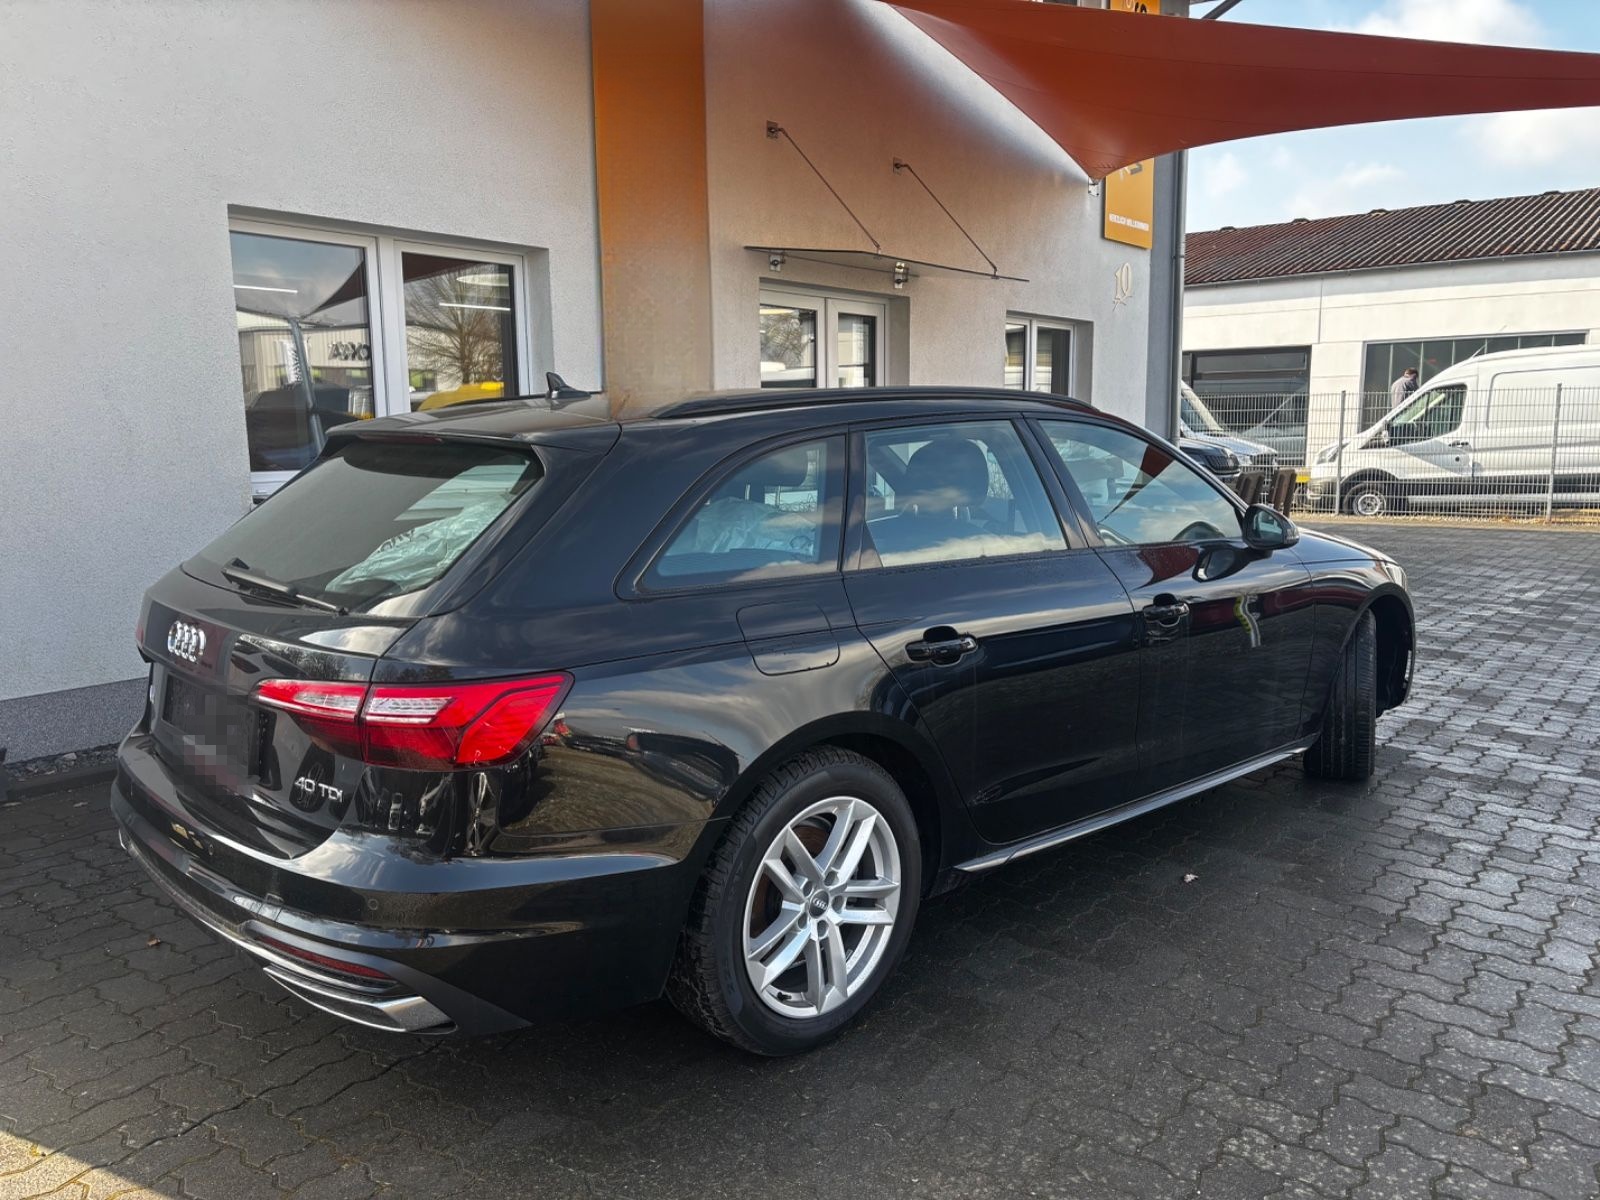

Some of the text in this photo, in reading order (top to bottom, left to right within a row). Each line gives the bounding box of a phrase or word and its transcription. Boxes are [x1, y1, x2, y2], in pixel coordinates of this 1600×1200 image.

[1114, 262, 1133, 300] 10
[294, 776, 343, 803] 40 TDI
